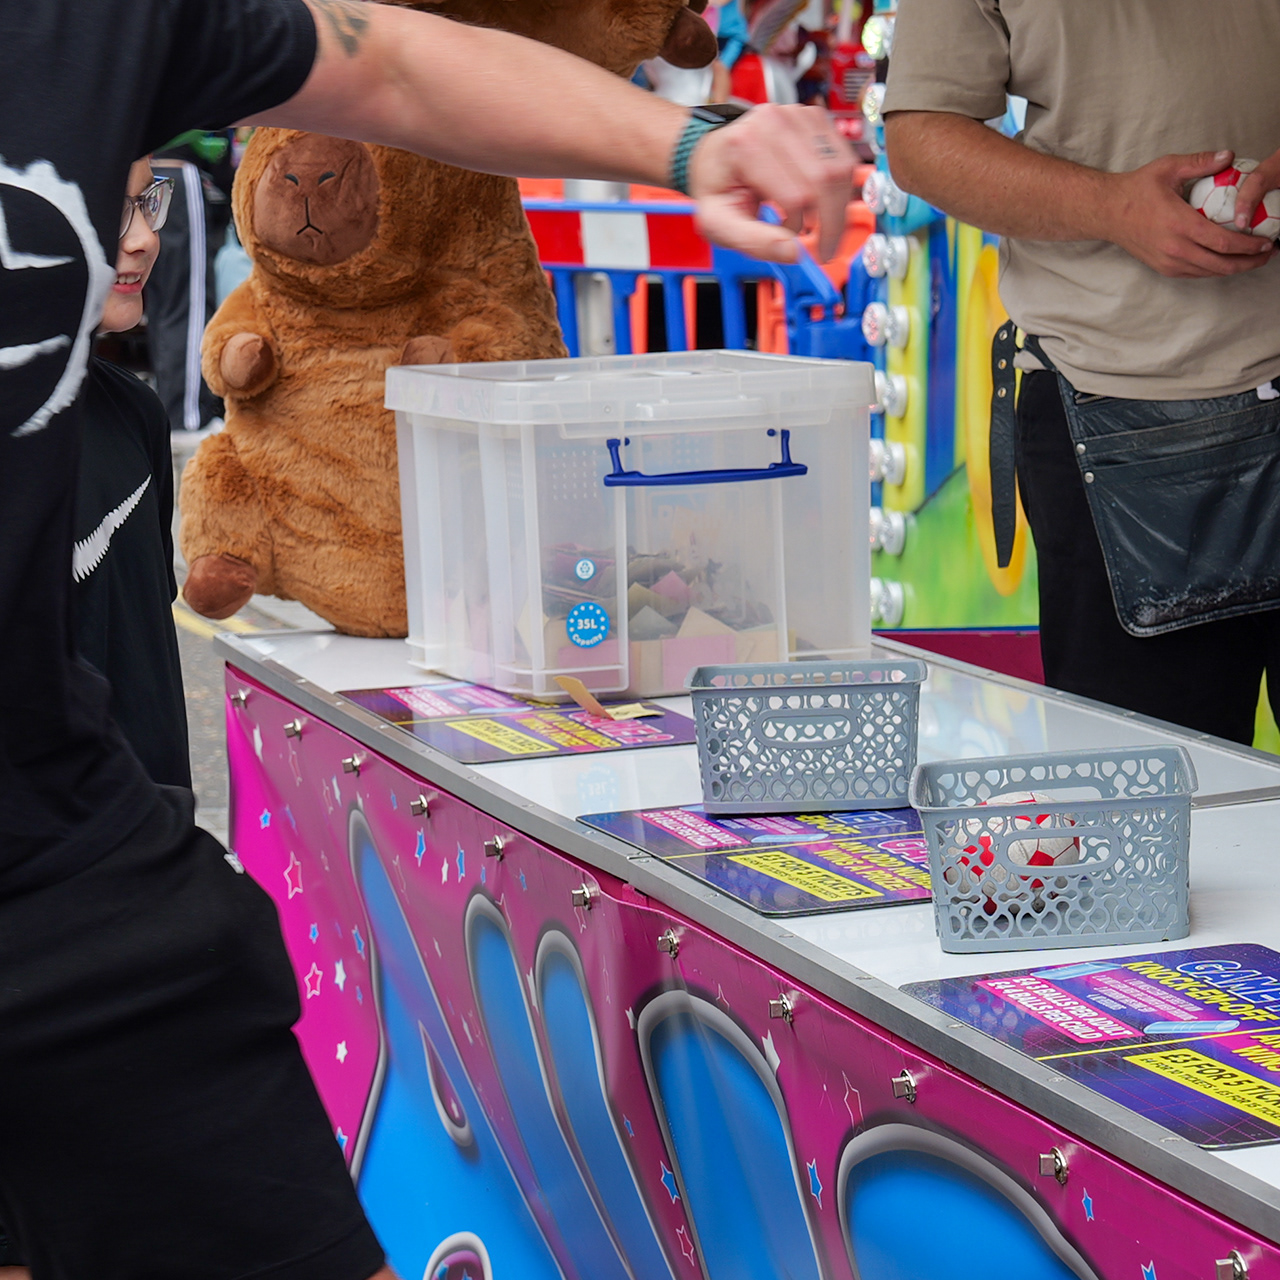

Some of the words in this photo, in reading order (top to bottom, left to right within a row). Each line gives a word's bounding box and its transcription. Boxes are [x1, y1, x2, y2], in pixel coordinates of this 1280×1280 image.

[572, 632, 603, 646] Capacity
[577, 618, 598, 630] 35L
[1008, 991, 1054, 1012] BALLS
[1038, 1008, 1074, 1023] PER
[1059, 1020, 1103, 1039] CHILD
[1032, 988, 1079, 1007] BALLS
[1064, 1003, 1099, 1019] PER
[1084, 1016, 1134, 1036] ADULT
[1161, 1053, 1201, 1064] £3
[1183, 1062, 1238, 1082] FOR
[1224, 1079, 1254, 1087] 5
